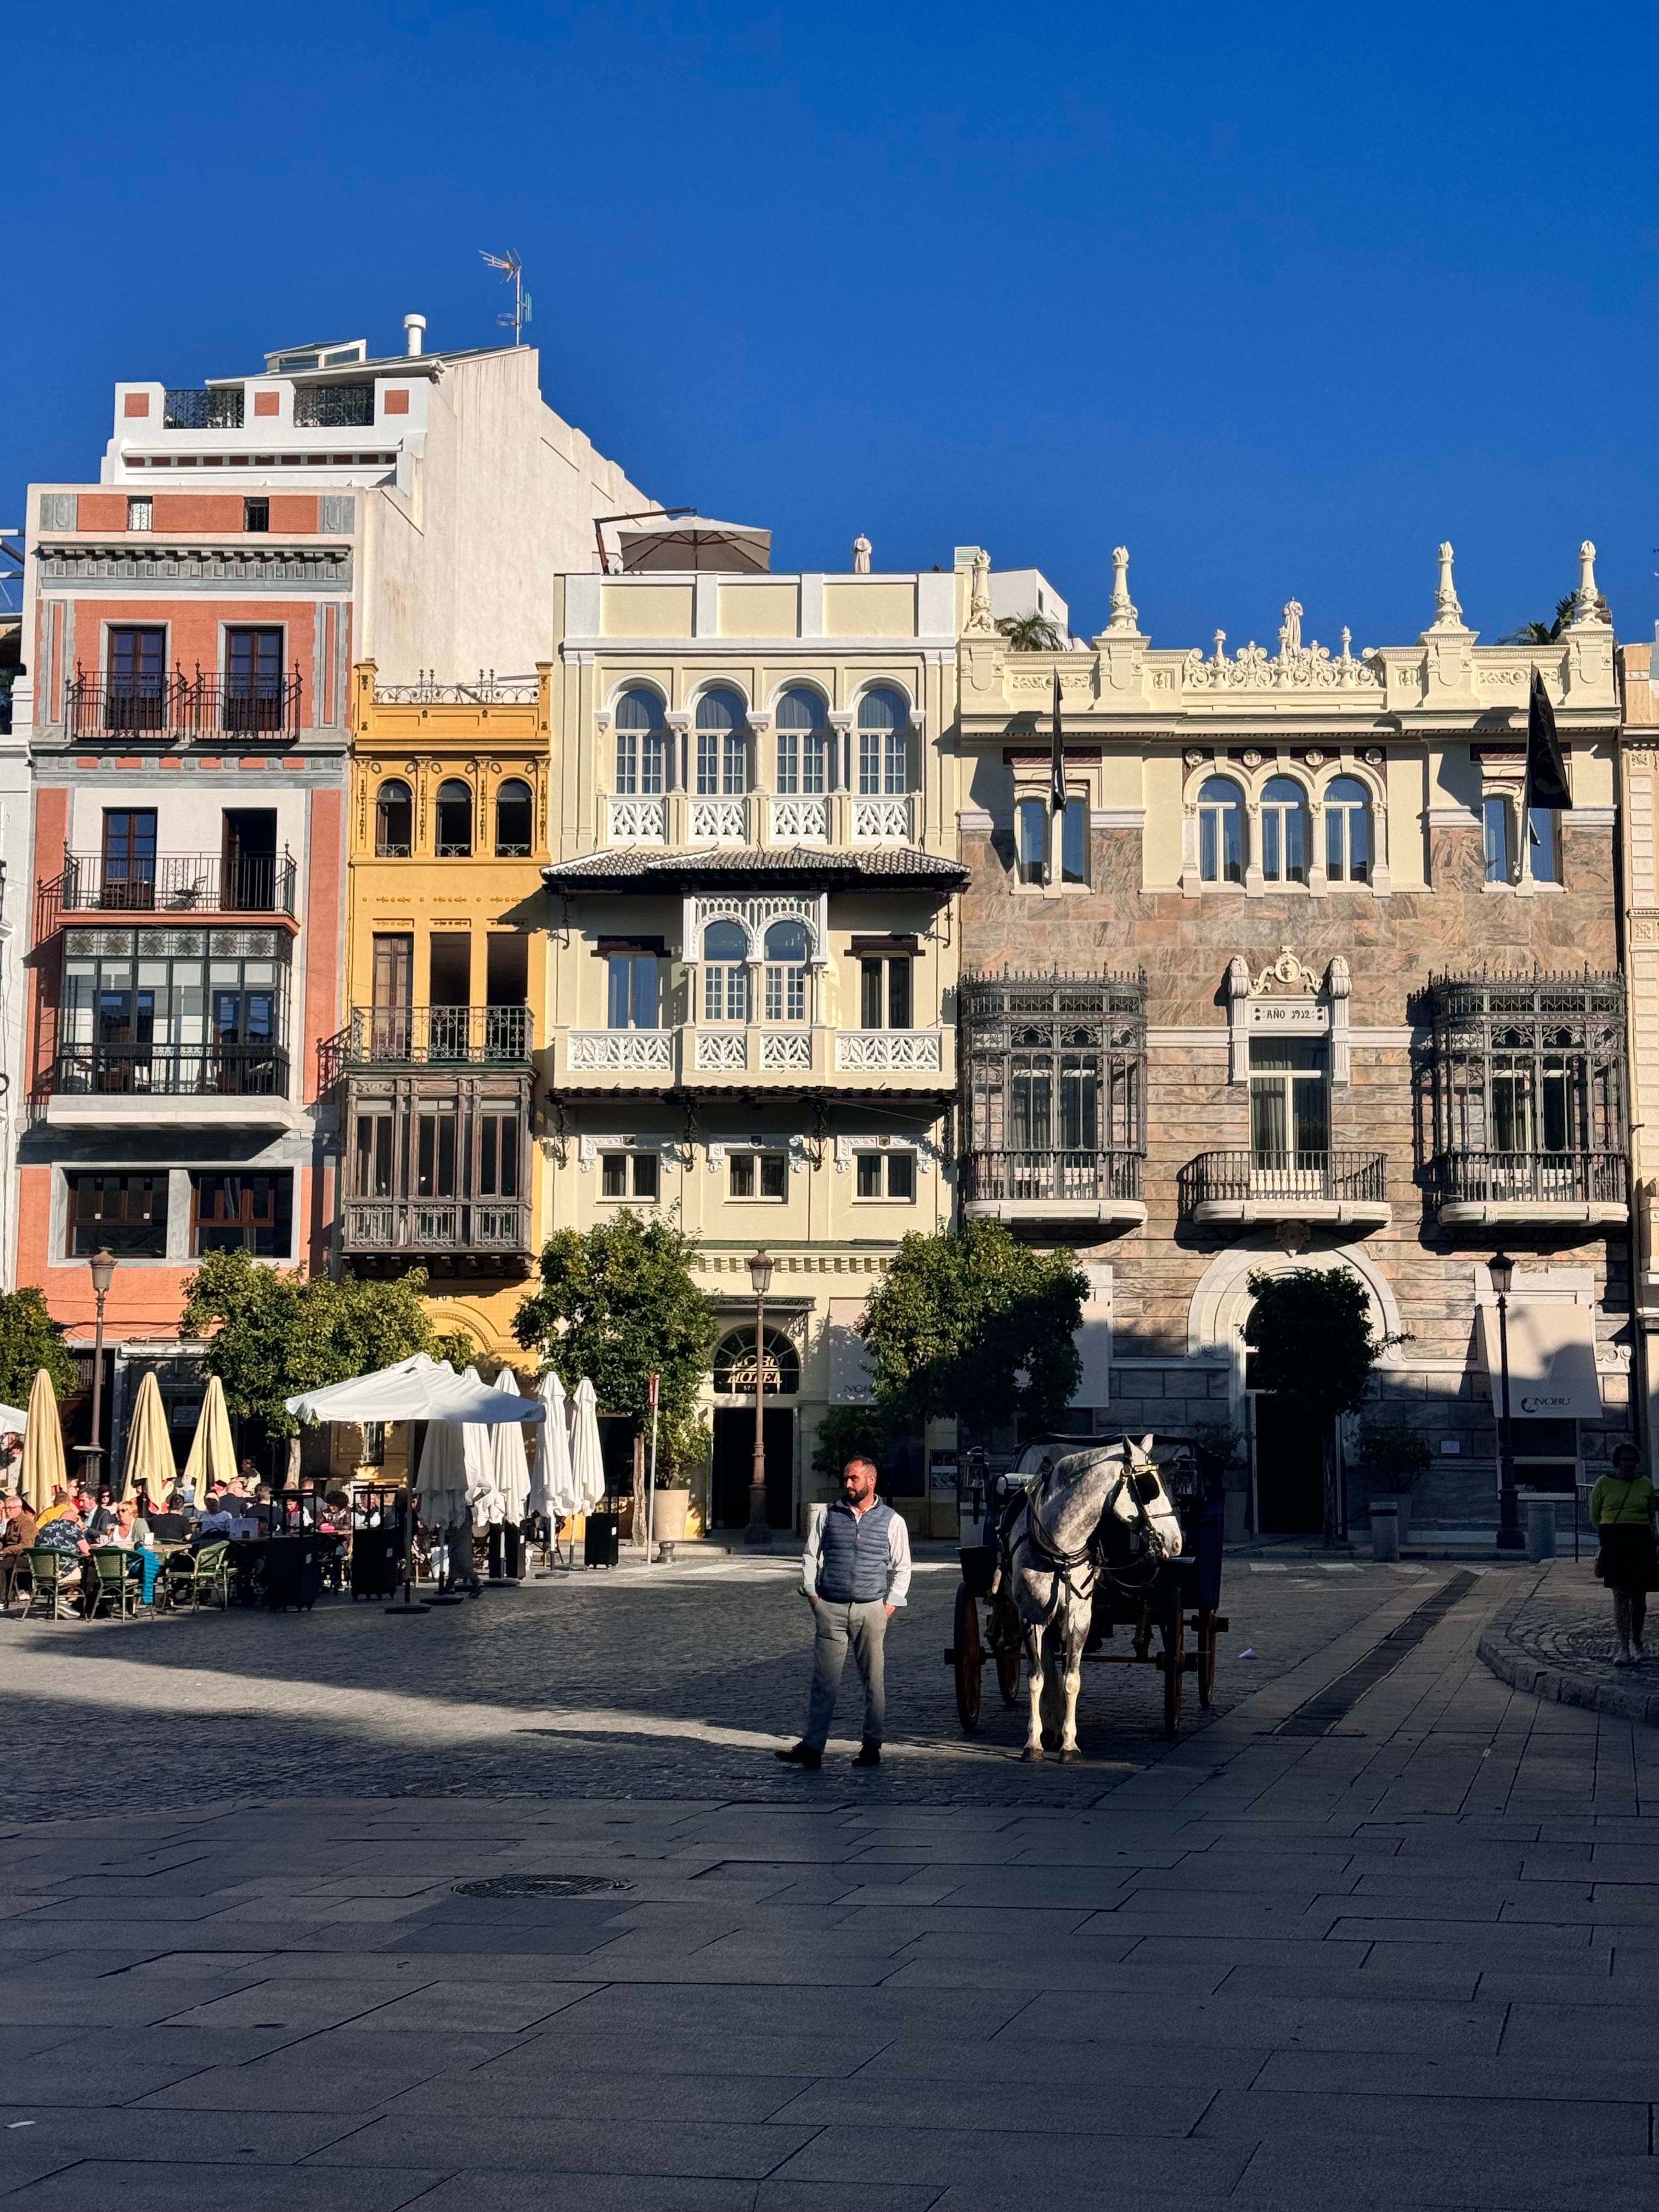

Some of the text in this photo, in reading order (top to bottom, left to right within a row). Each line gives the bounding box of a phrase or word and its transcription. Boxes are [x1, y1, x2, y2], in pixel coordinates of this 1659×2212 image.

[1267, 1007, 1311, 1019] AÑO 1912
[1533, 1397, 1572, 1406] NOBU
